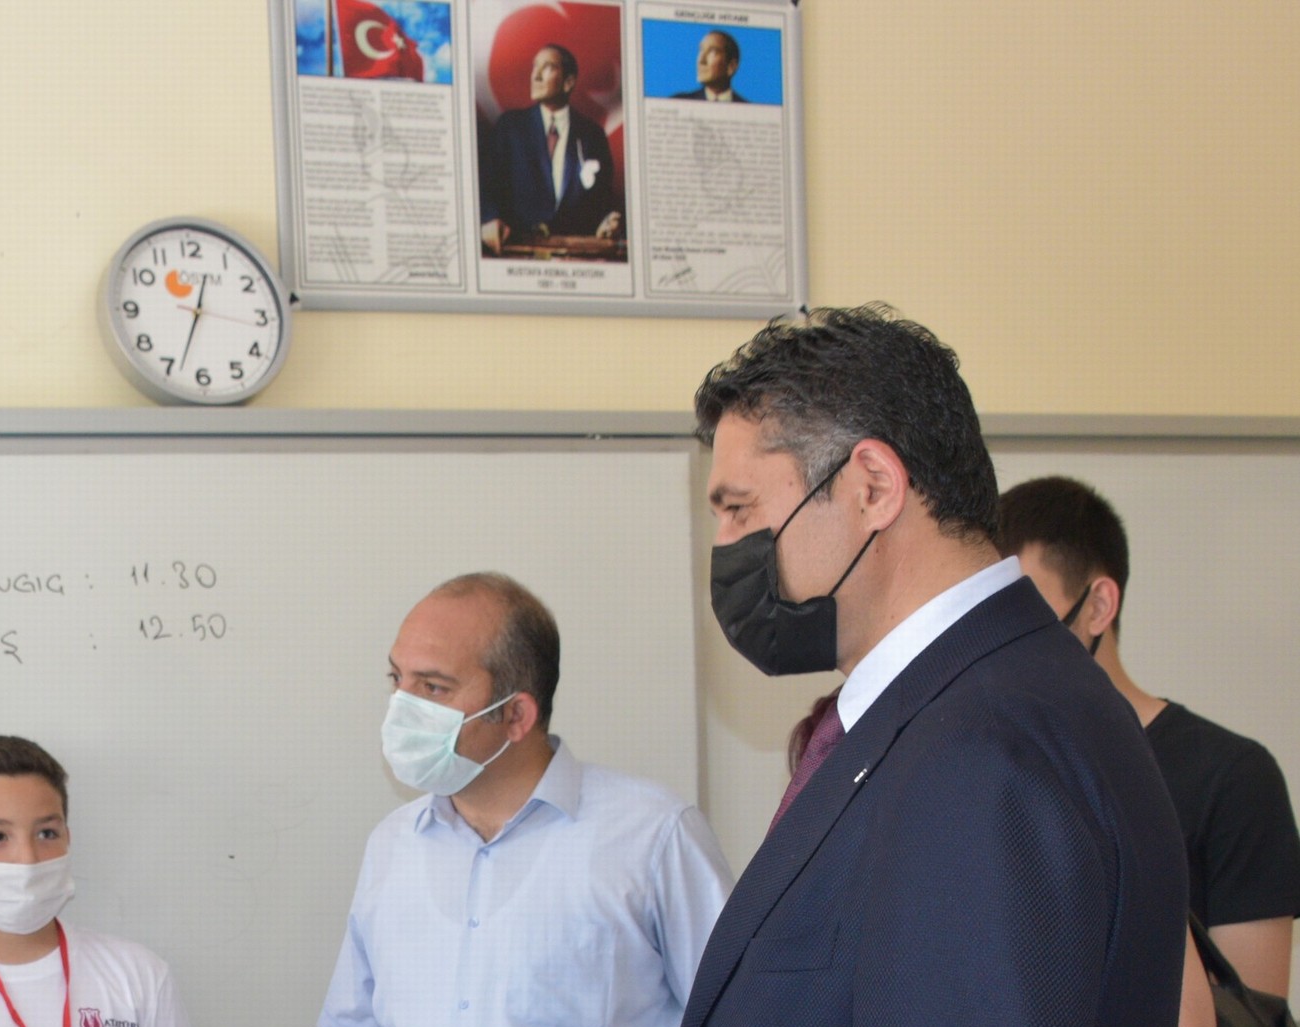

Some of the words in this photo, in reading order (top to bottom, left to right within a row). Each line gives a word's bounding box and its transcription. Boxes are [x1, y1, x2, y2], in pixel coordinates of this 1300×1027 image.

[153, 248, 166, 266] 11
[180, 241, 201, 258] 12
[222, 252, 228, 270] 1
[133, 268, 156, 286] 10
[240, 275, 256, 293] 2
[123, 301, 139, 319] 9
[254, 309, 269, 327] 3
[136, 333, 153, 352] 8
[249, 342, 262, 358] 4
[159, 357, 175, 376] 7
[230, 361, 244, 380] 5
[195, 368, 211, 386] 6
[131, 560, 217, 589] 11.30
[139, 612, 227, 642] 12.50
